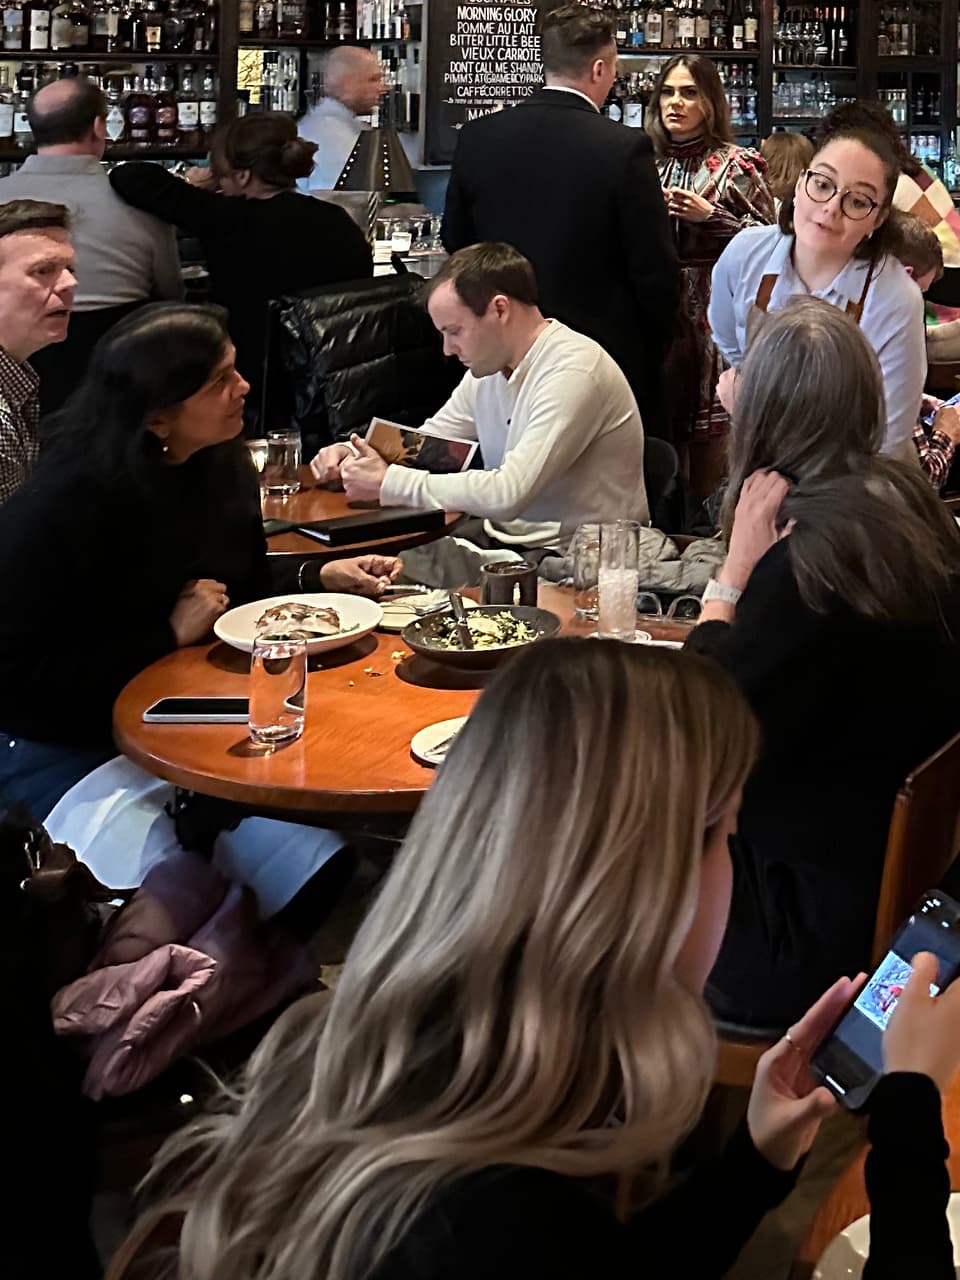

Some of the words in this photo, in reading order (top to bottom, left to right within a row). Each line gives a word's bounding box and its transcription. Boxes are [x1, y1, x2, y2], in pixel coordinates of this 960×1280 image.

[457, 6, 502, 21] MORNING
[504, 7, 537, 22] GLORY
[457, 22, 495, 34] POMME
[497, 23, 511, 35] AU
[513, 23, 536, 35] LAIT
[450, 33, 484, 46] BITTER
[486, 34, 518, 47] LITTLE
[521, 35, 541, 48] BEE
[461, 47, 495, 60] VIEUX
[497, 48, 541, 61] CARROTE
[475, 62, 493, 74] CALL
[495, 62, 508, 73] ME
[510, 62, 544, 74] SHANDY
